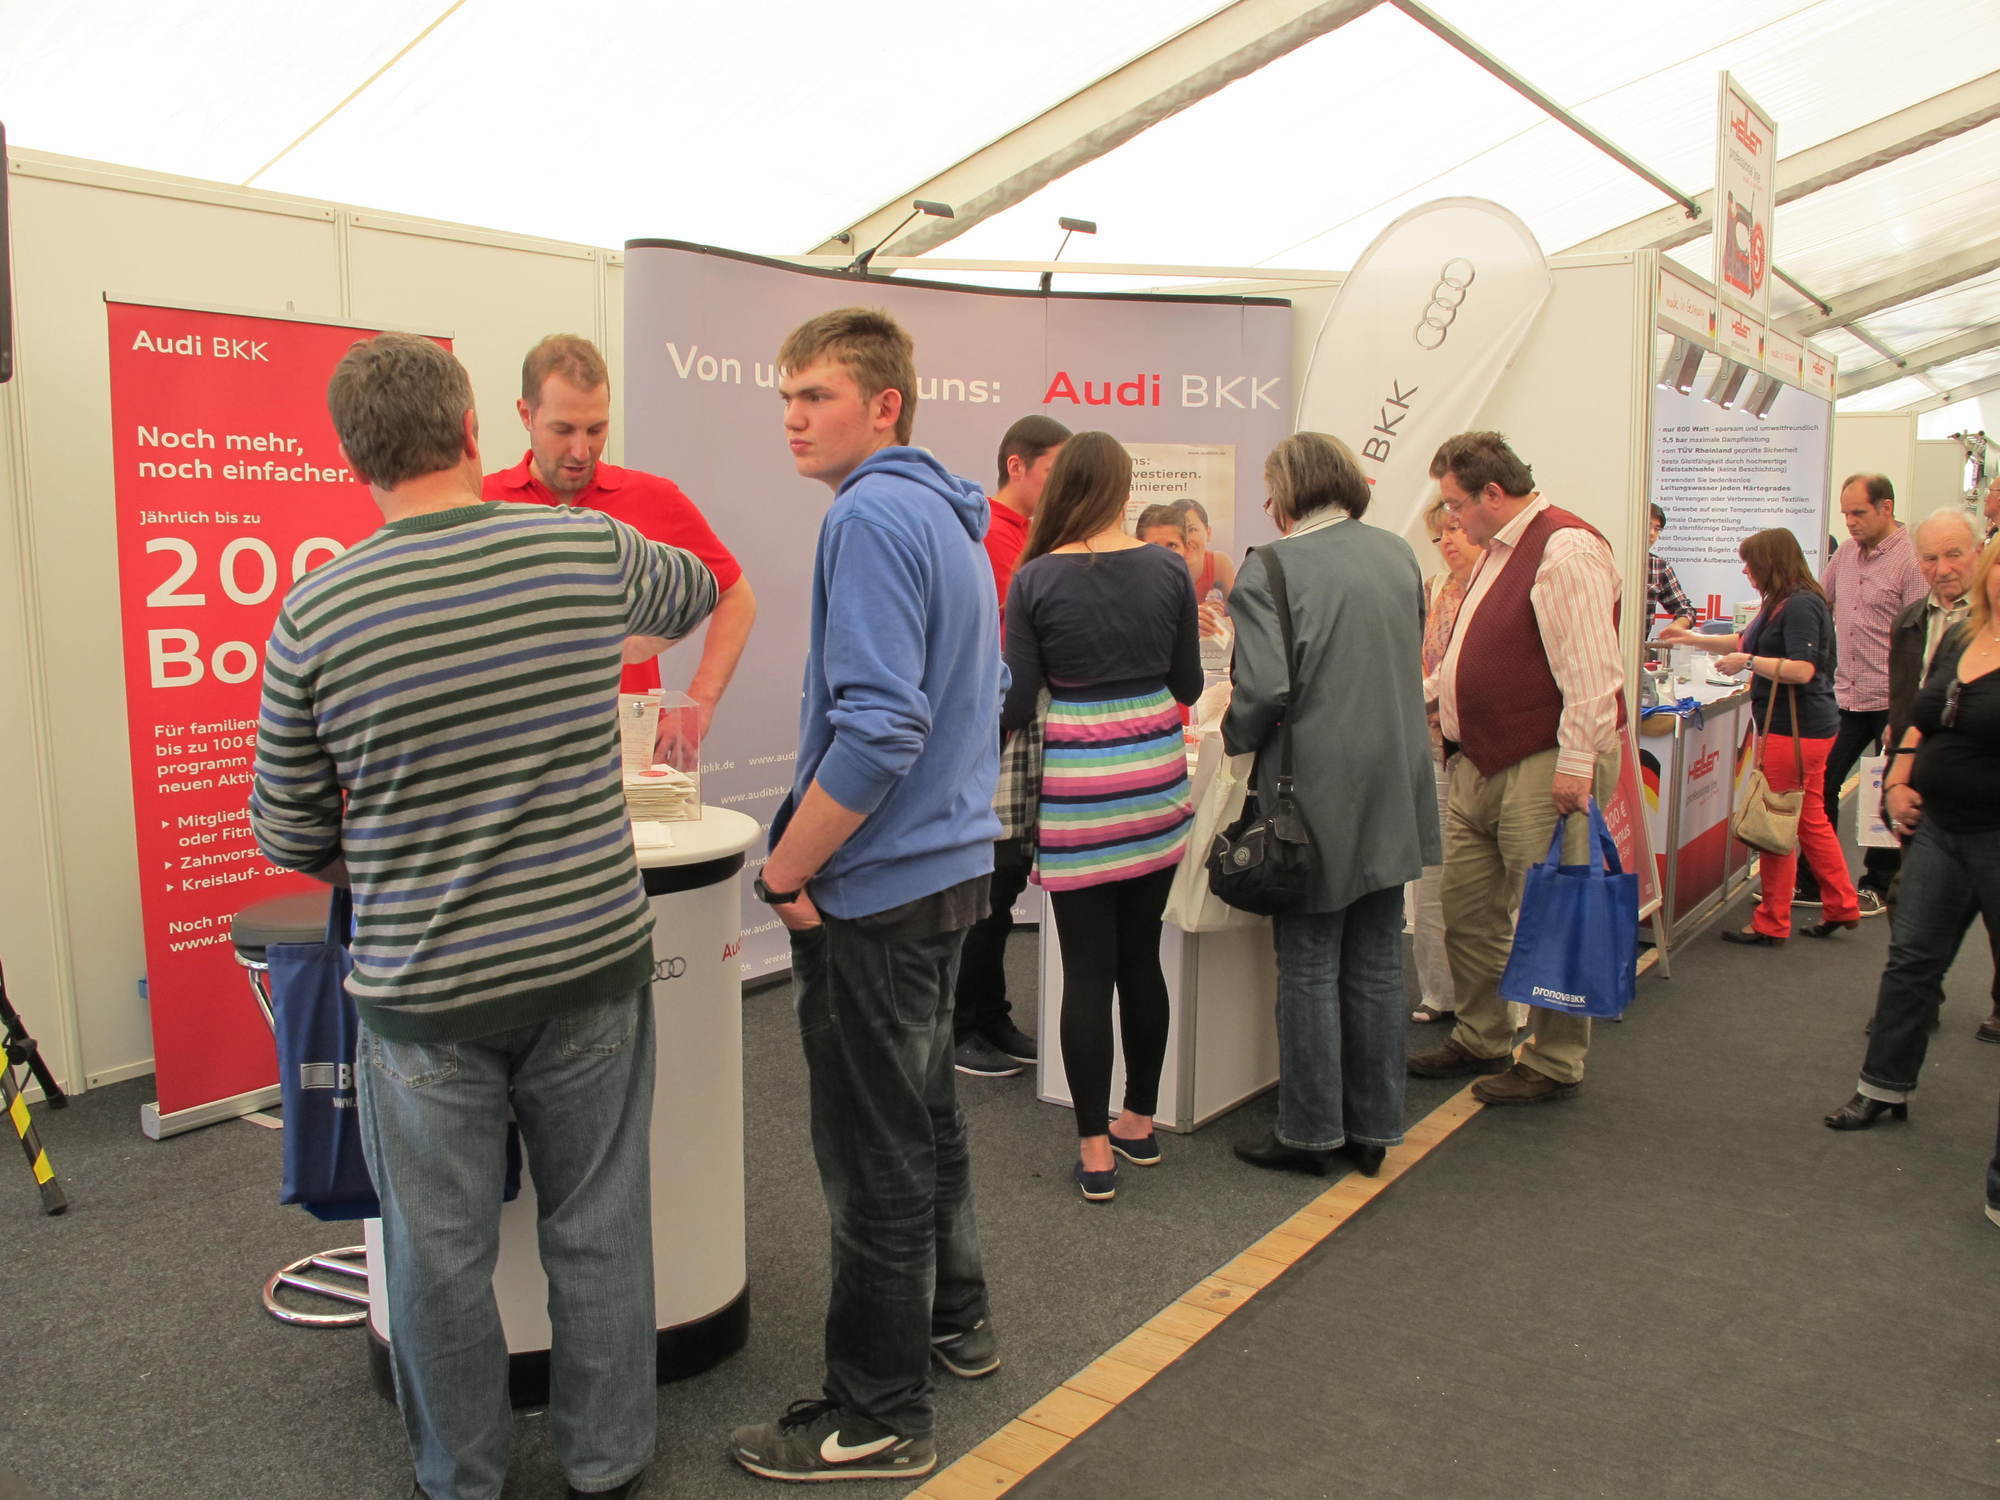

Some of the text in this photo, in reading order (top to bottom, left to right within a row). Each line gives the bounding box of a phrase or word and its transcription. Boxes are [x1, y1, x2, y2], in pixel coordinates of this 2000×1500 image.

[132, 330, 270, 362] Audi BKK
[666, 342, 741, 384] Von
[916, 376, 1000, 403] uns:
[1042, 371, 1160, 406] Audi
[1181, 374, 1281, 410] BKK
[1361, 378, 1419, 463] BKK
[137, 425, 304, 456] Noch mehr,
[138, 459, 354, 483] noch einfacher.
[140, 510, 261, 525] Jährlich bis zu
[148, 629, 270, 688] Bo
[154, 718, 259, 738] Für familien
[156, 744, 182, 757] bis
[188, 741, 207, 753] zu
[157, 756, 247, 778] programm
[159, 778, 213, 794] neuen
[720, 786, 792, 805] www.audibkk.
[178, 831, 217, 847] oder
[182, 867, 260, 891] Kreislauf-
[169, 912, 238, 934] Noch m
